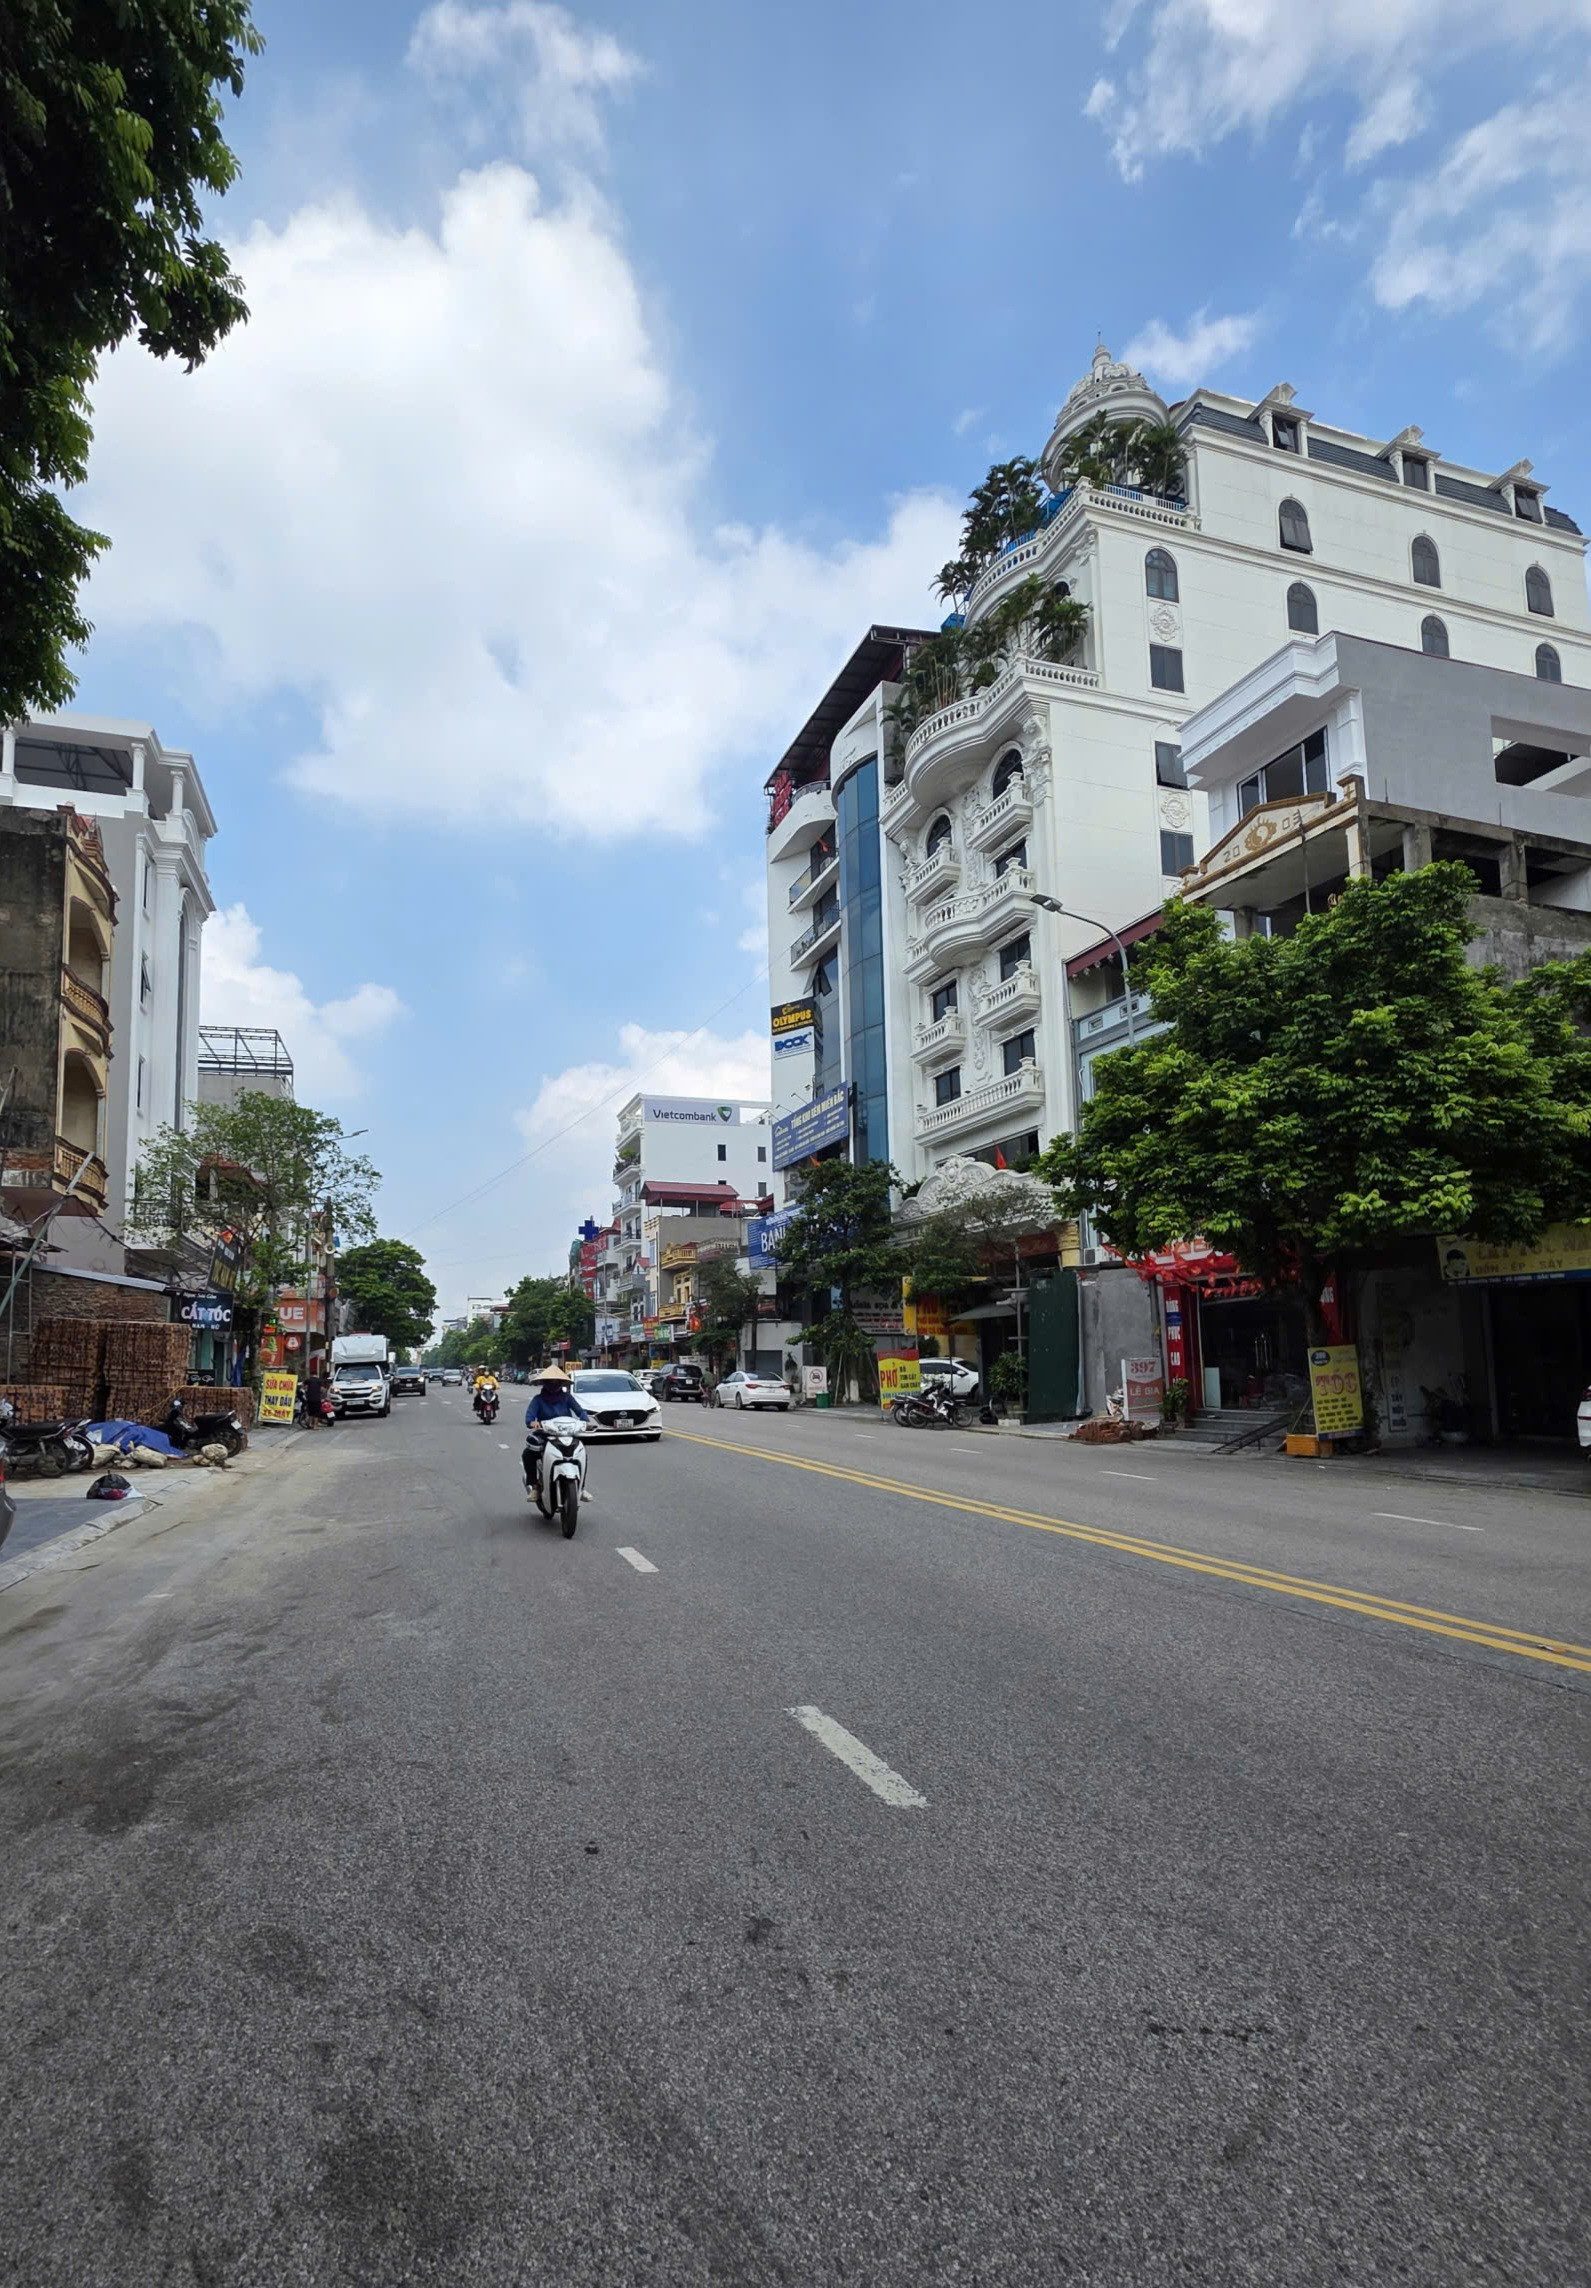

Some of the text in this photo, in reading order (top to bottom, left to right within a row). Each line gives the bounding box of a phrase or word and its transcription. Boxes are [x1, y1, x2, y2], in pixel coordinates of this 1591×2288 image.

[773, 1009, 812, 1028] OLYMPUS
[653, 1109, 717, 1122] Vietcombank
[181, 1301, 231, 1322] CẮT TÓC
[880, 1362, 898, 1388] PHỞ
[1130, 1361, 1156, 1373] 397
